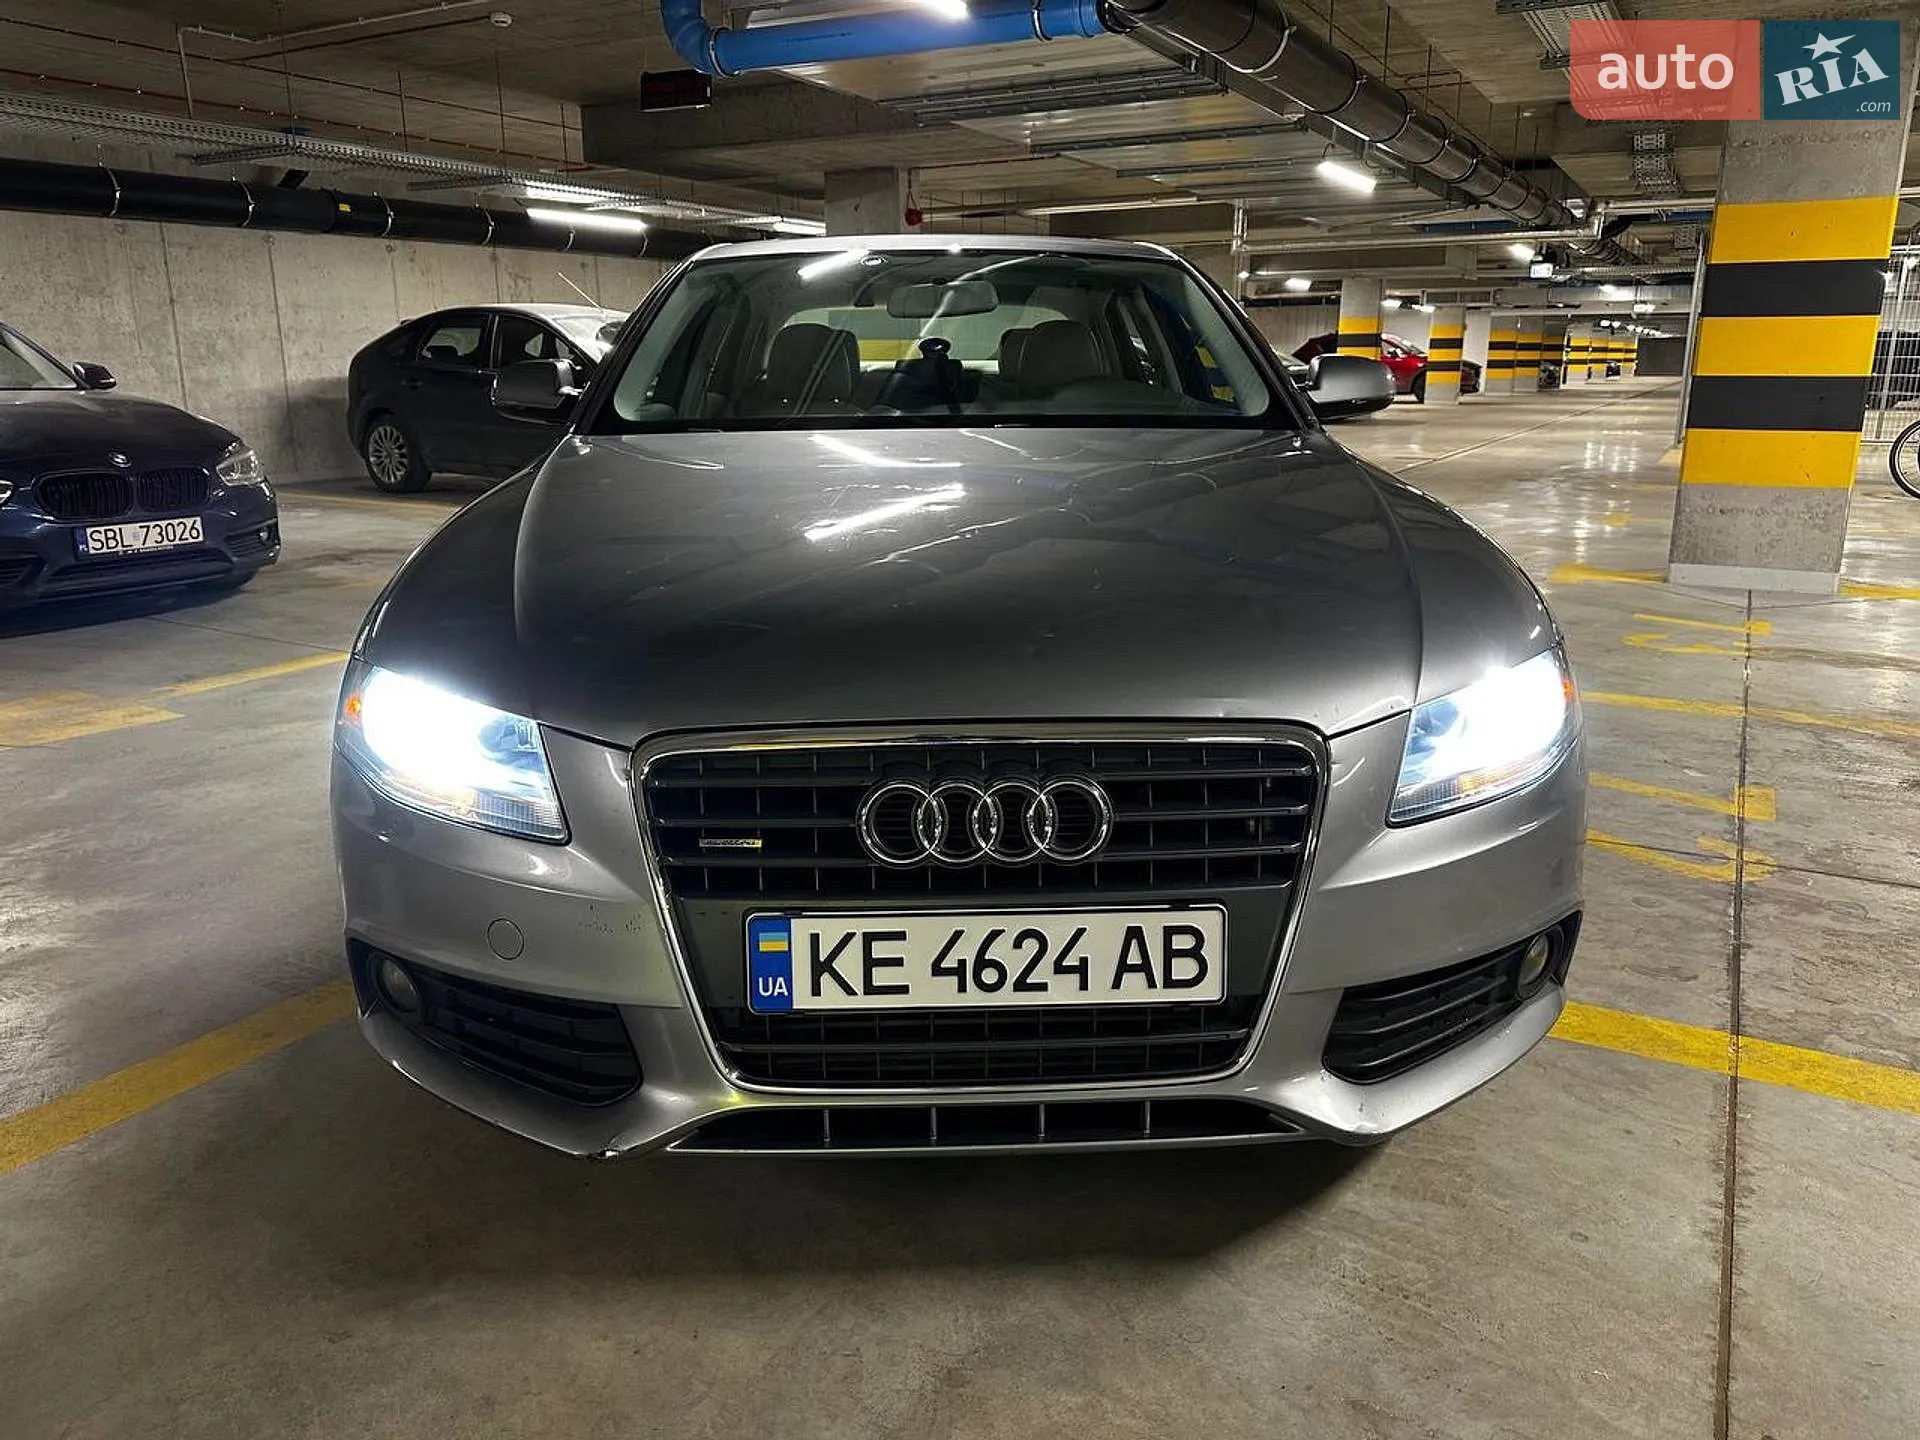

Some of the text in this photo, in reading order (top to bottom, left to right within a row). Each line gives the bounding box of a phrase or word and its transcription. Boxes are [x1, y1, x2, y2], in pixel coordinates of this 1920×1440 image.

[89, 528, 133, 551] SBL
[139, 520, 201, 546] 73026
[809, 925, 1209, 997] KE 4624 AB
[758, 976, 789, 997] UA
